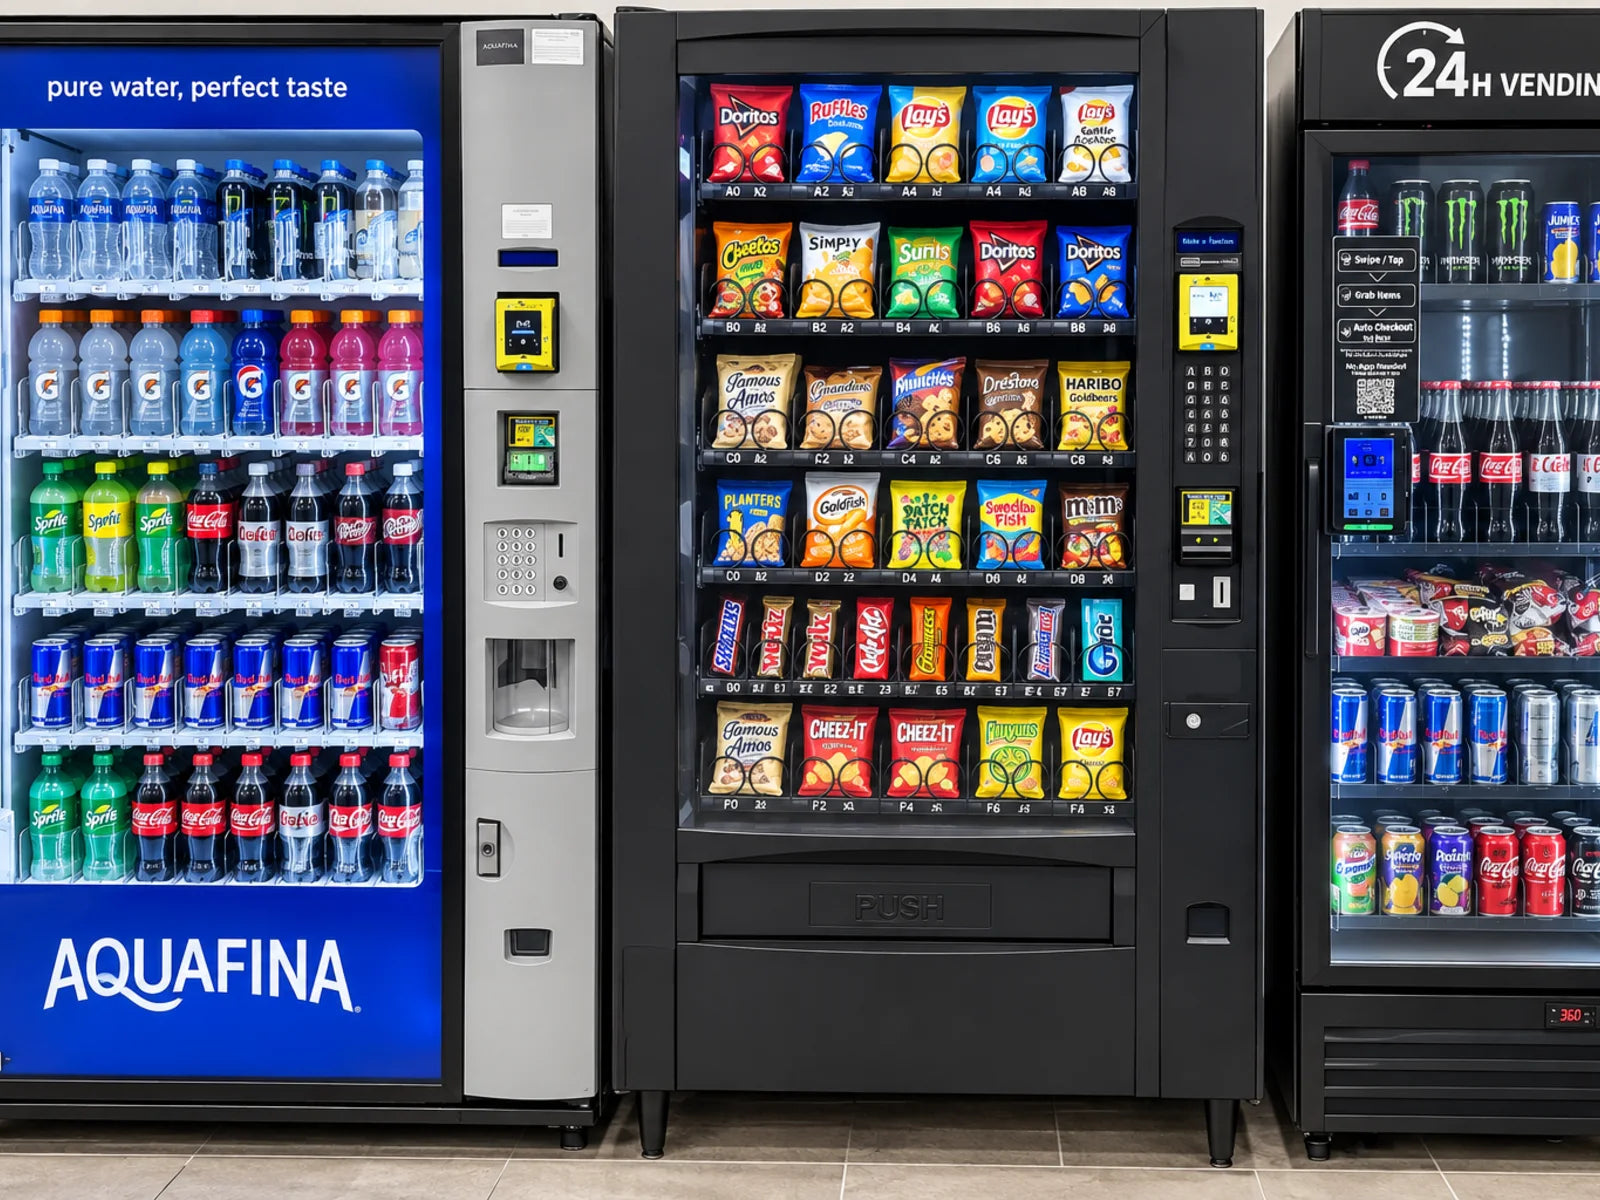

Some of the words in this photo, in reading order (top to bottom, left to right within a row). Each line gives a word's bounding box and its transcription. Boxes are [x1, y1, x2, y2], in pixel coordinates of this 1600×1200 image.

[47, 78, 102, 102] pure
[111, 77, 184, 101] water,
[191, 75, 280, 102] perfect
[286, 77, 348, 98] taste
[1500, 73, 1600, 97] VENDIN
[720, 107, 778, 125] Doritos
[991, 103, 1034, 128] Lay's
[725, 186, 741, 196] A0
[814, 186, 829, 196] A2
[902, 187, 917, 197] A4
[986, 187, 1001, 197] A4
[722, 236, 780, 269] Cheetos
[981, 243, 1036, 260] Doritos
[1067, 244, 1121, 261] Doritos
[1354, 254, 1380, 266] Swipe
[1354, 290, 1376, 300] Grab
[1377, 290, 1401, 300] Items
[726, 322, 741, 333] B0
[812, 322, 827, 333] B2
[896, 322, 910, 333] B4
[986, 322, 1000, 333] B6
[1374, 322, 1414, 332] Checkout
[1066, 378, 1122, 391] HARIBO
[726, 453, 741, 463] C0
[902, 454, 916, 464] C4
[986, 454, 1001, 464] C6
[725, 494, 781, 509] PLANTERS
[726, 570, 740, 581] C0
[815, 571, 829, 582] D2
[902, 572, 917, 583] D4
[810, 719, 867, 740] CHEEZ-IT
[897, 722, 955, 743] CHEEZ-IT
[856, 894, 944, 921] PUSH
[43, 937, 354, 1013] AQUAFINA
[1560, 1008, 1582, 1022] 360
